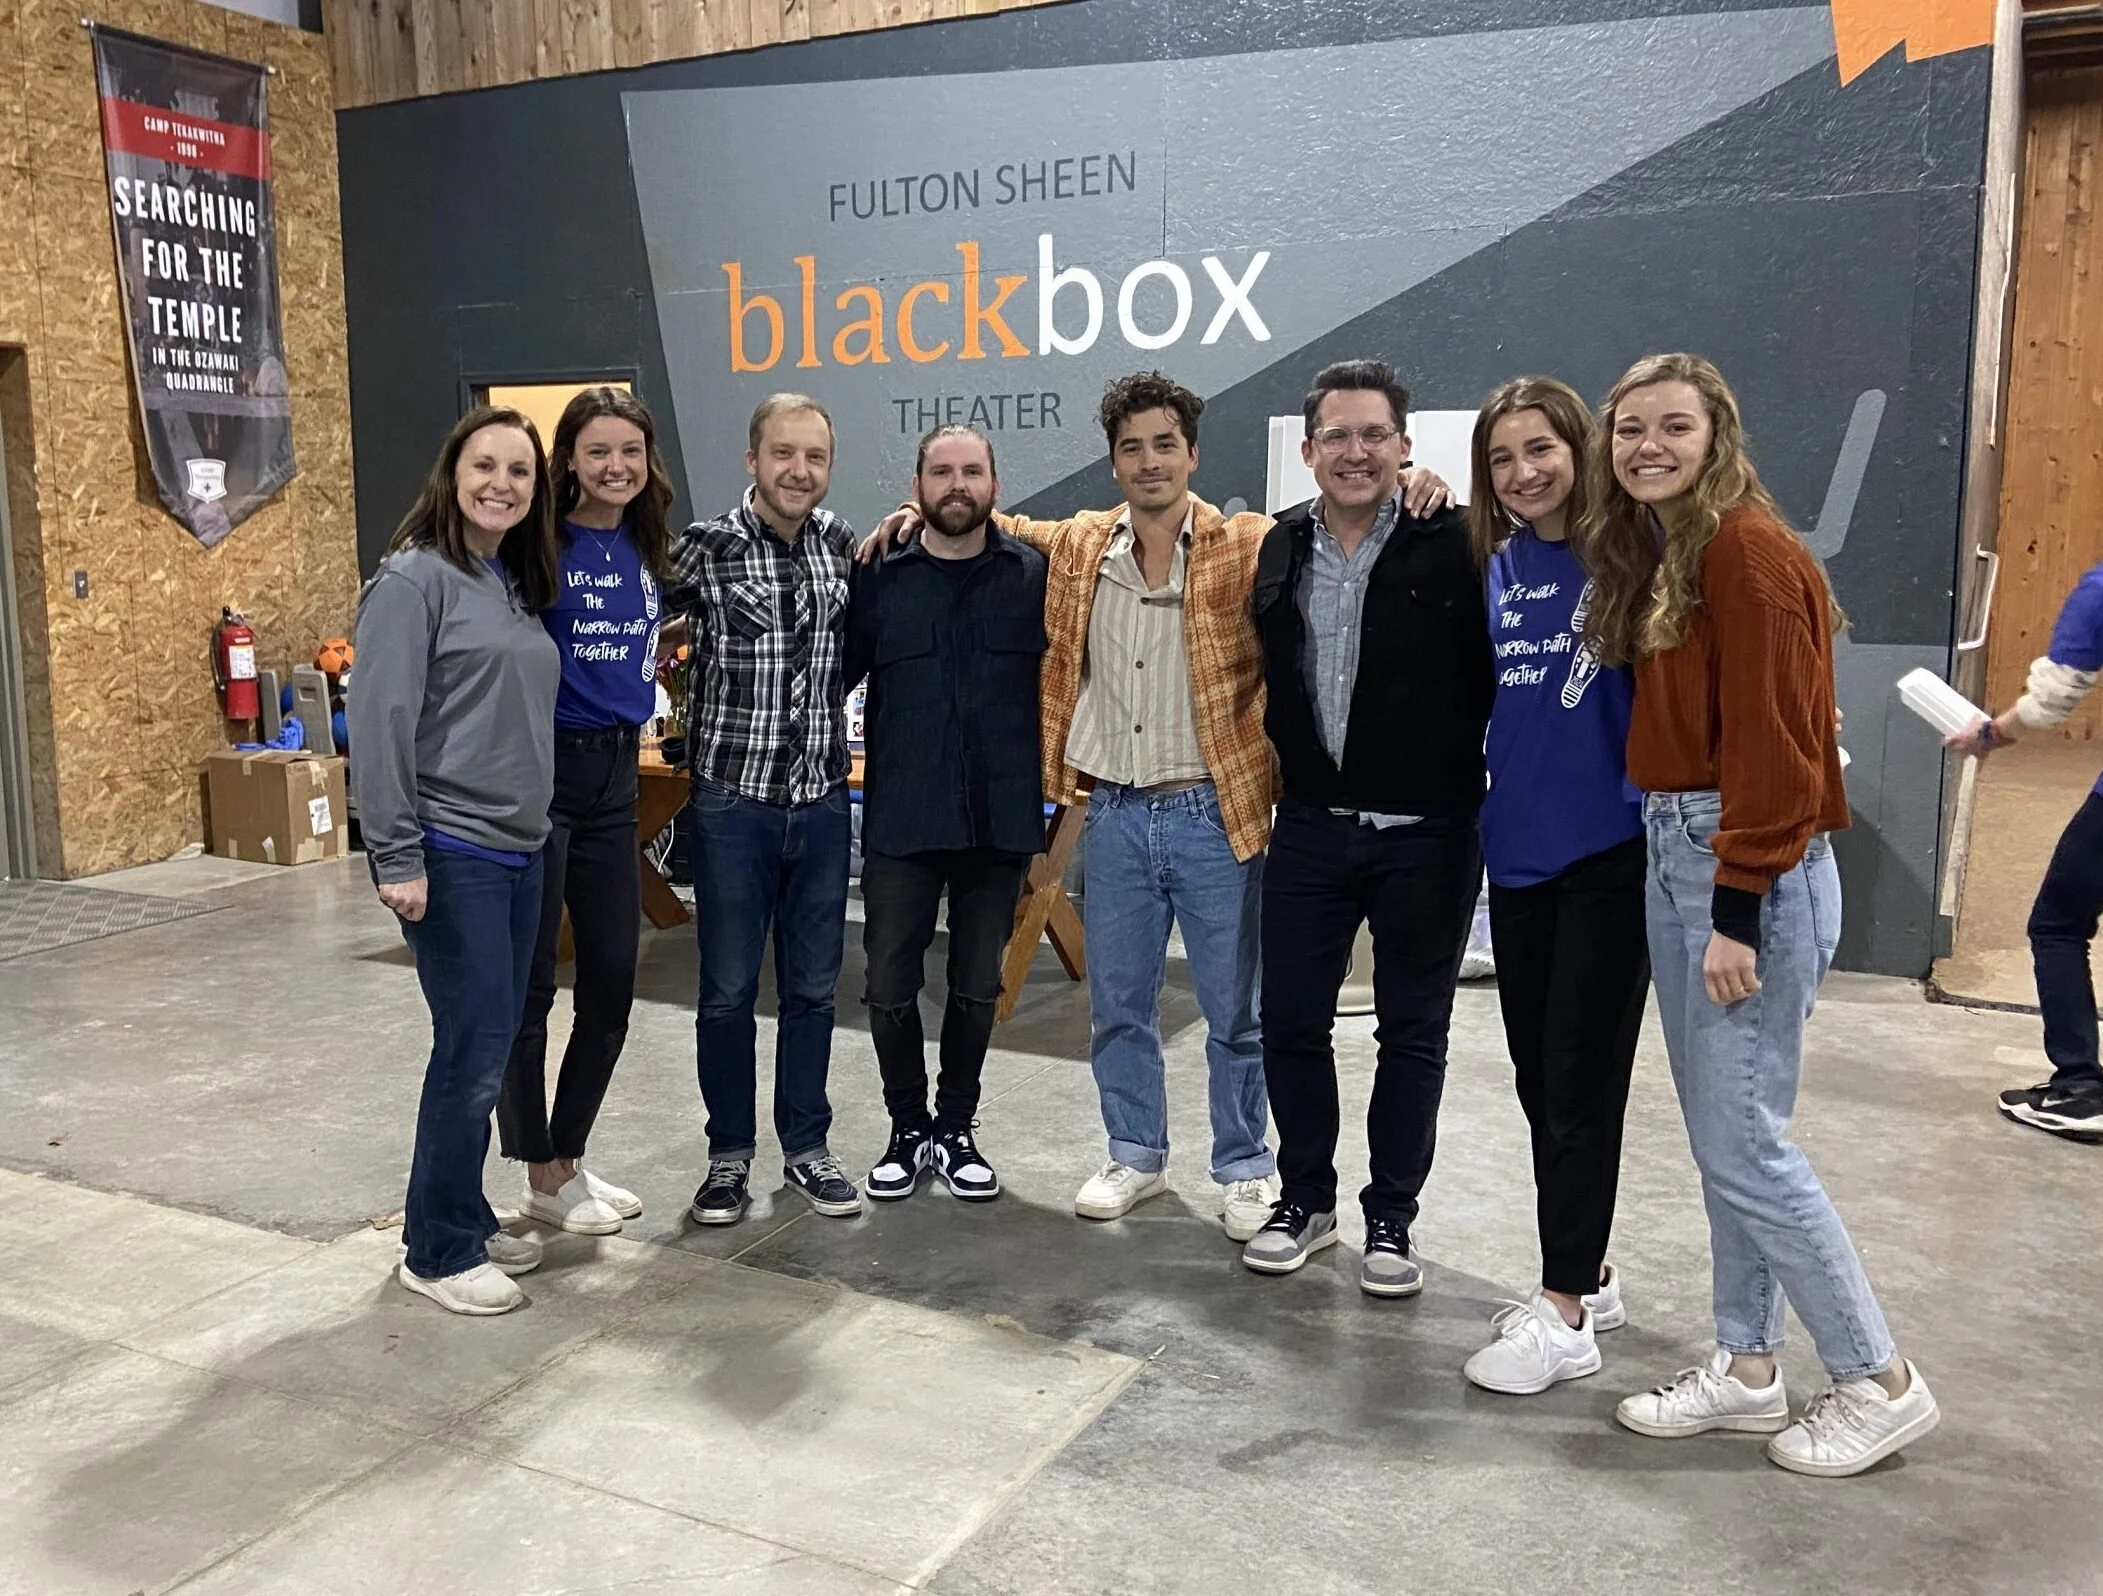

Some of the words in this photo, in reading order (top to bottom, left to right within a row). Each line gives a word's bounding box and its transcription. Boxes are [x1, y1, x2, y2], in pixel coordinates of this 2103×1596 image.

[144, 115, 170, 135] CAMP
[114, 175, 256, 238] SEARCHING
[829, 168, 981, 222] FULTON
[994, 150, 1137, 206] SHEEN
[142, 237, 190, 283] FOR
[198, 246, 243, 290] THE
[147, 296, 242, 344] TEMPLE
[152, 347, 166, 366] IN
[171, 348, 191, 368] THE
[194, 351, 239, 373] OZAWAKI
[165, 371, 234, 394] QUADRANGLE
[891, 391, 1062, 434] THEATER
